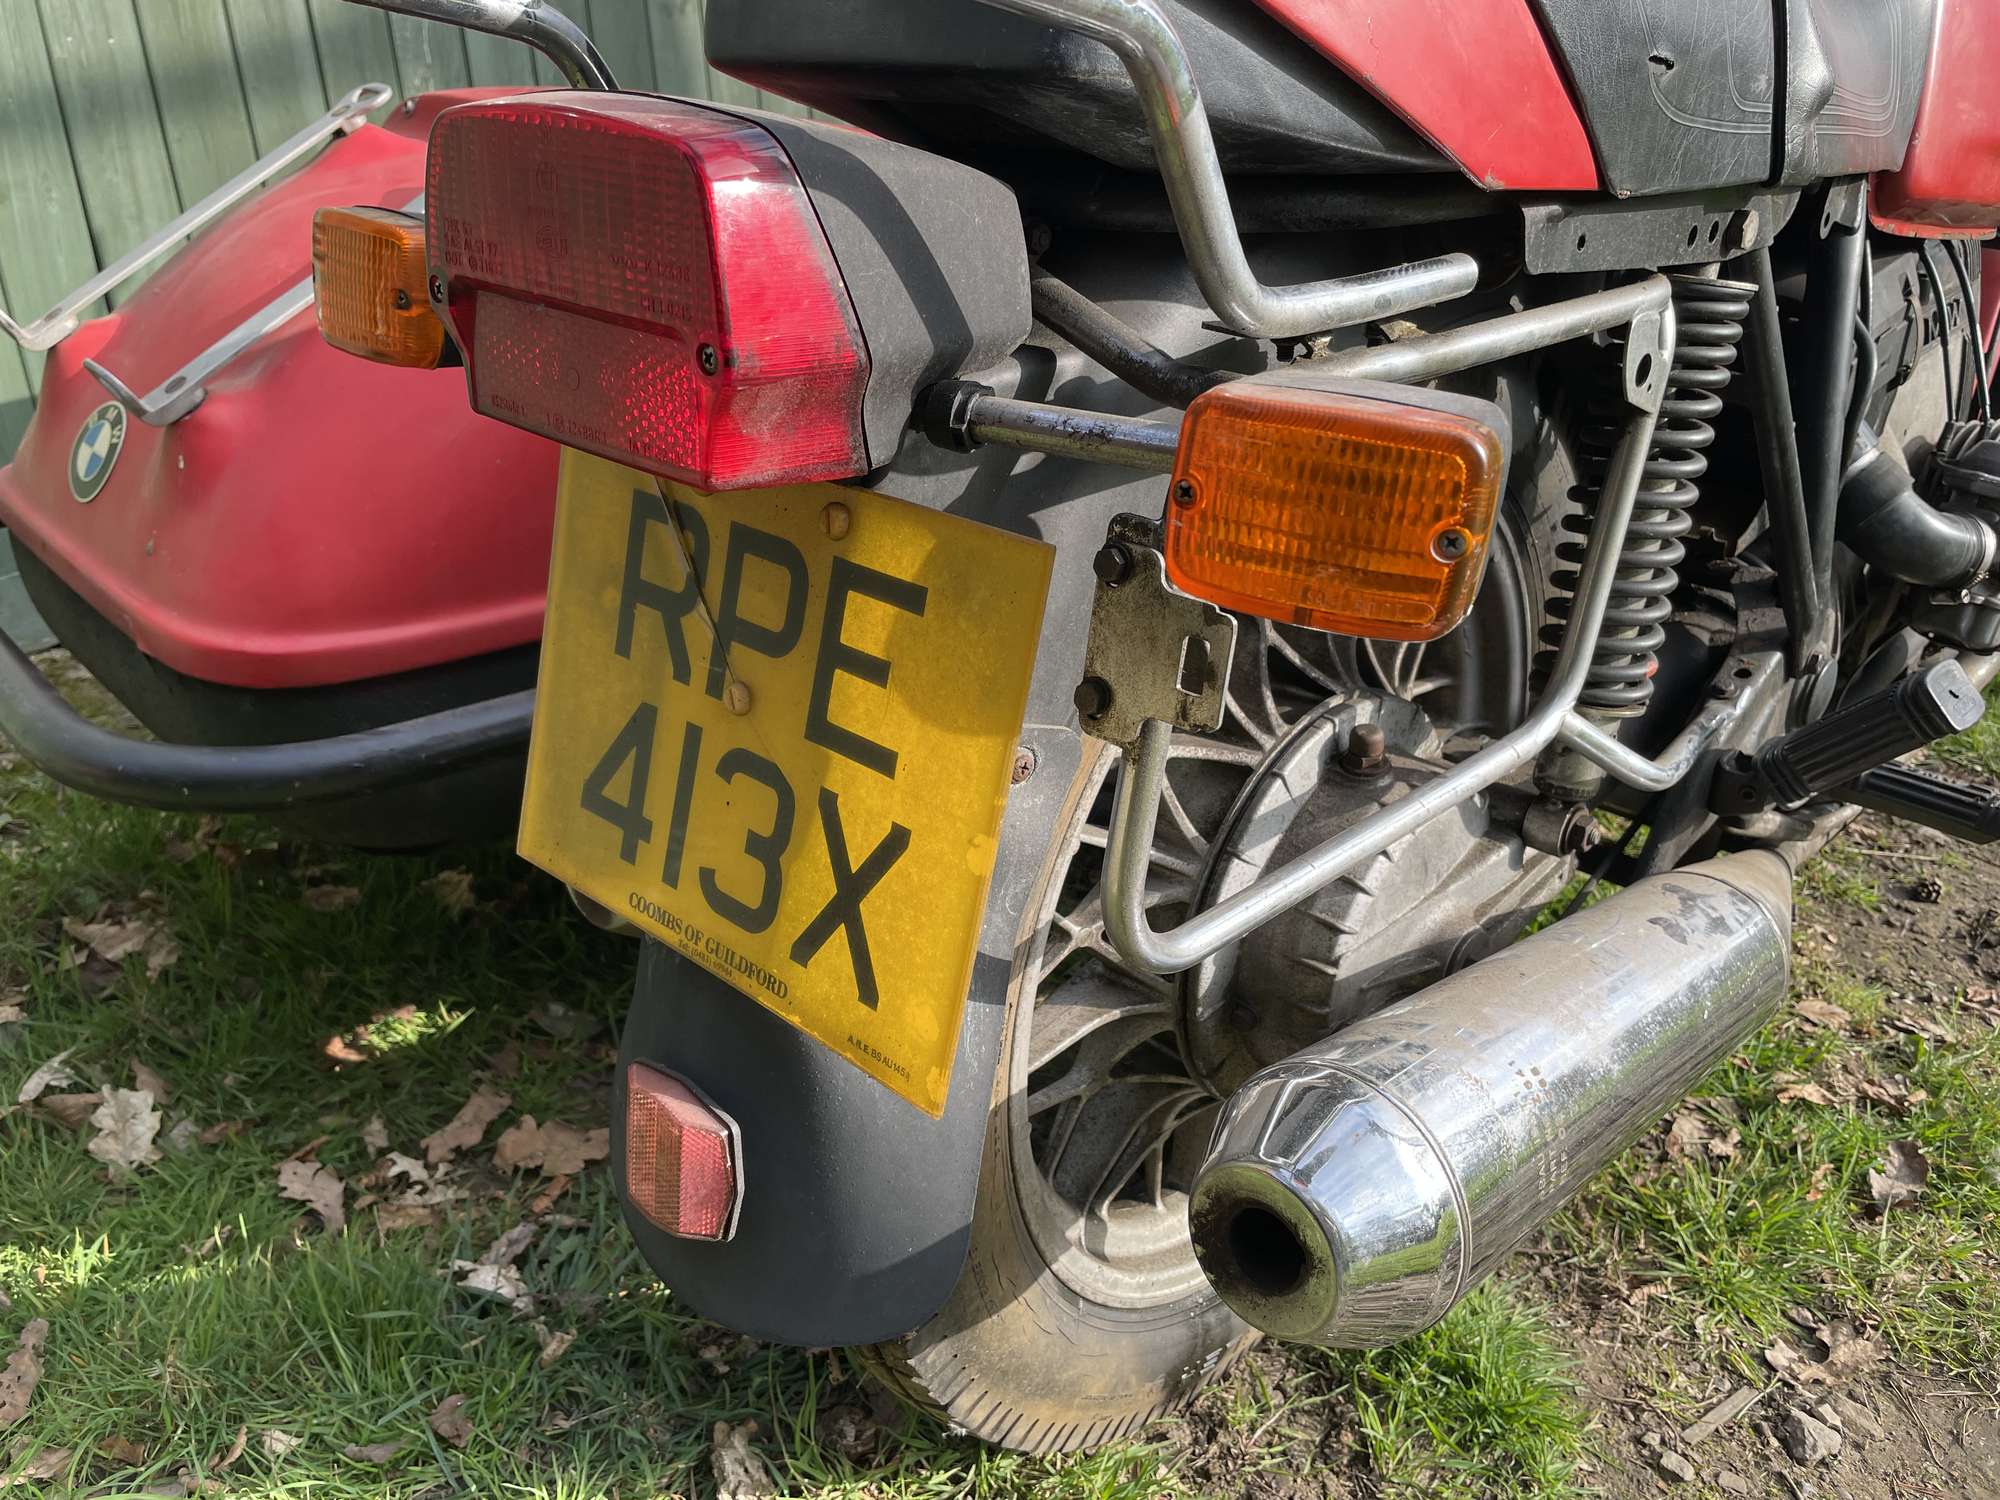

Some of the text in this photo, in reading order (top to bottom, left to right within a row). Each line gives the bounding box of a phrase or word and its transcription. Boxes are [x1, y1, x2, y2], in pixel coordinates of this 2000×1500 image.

[614, 488, 929, 780] RPE
[580, 702, 912, 1011] 413X
[628, 892, 789, 999] COOMBS OF GUILDFORD
